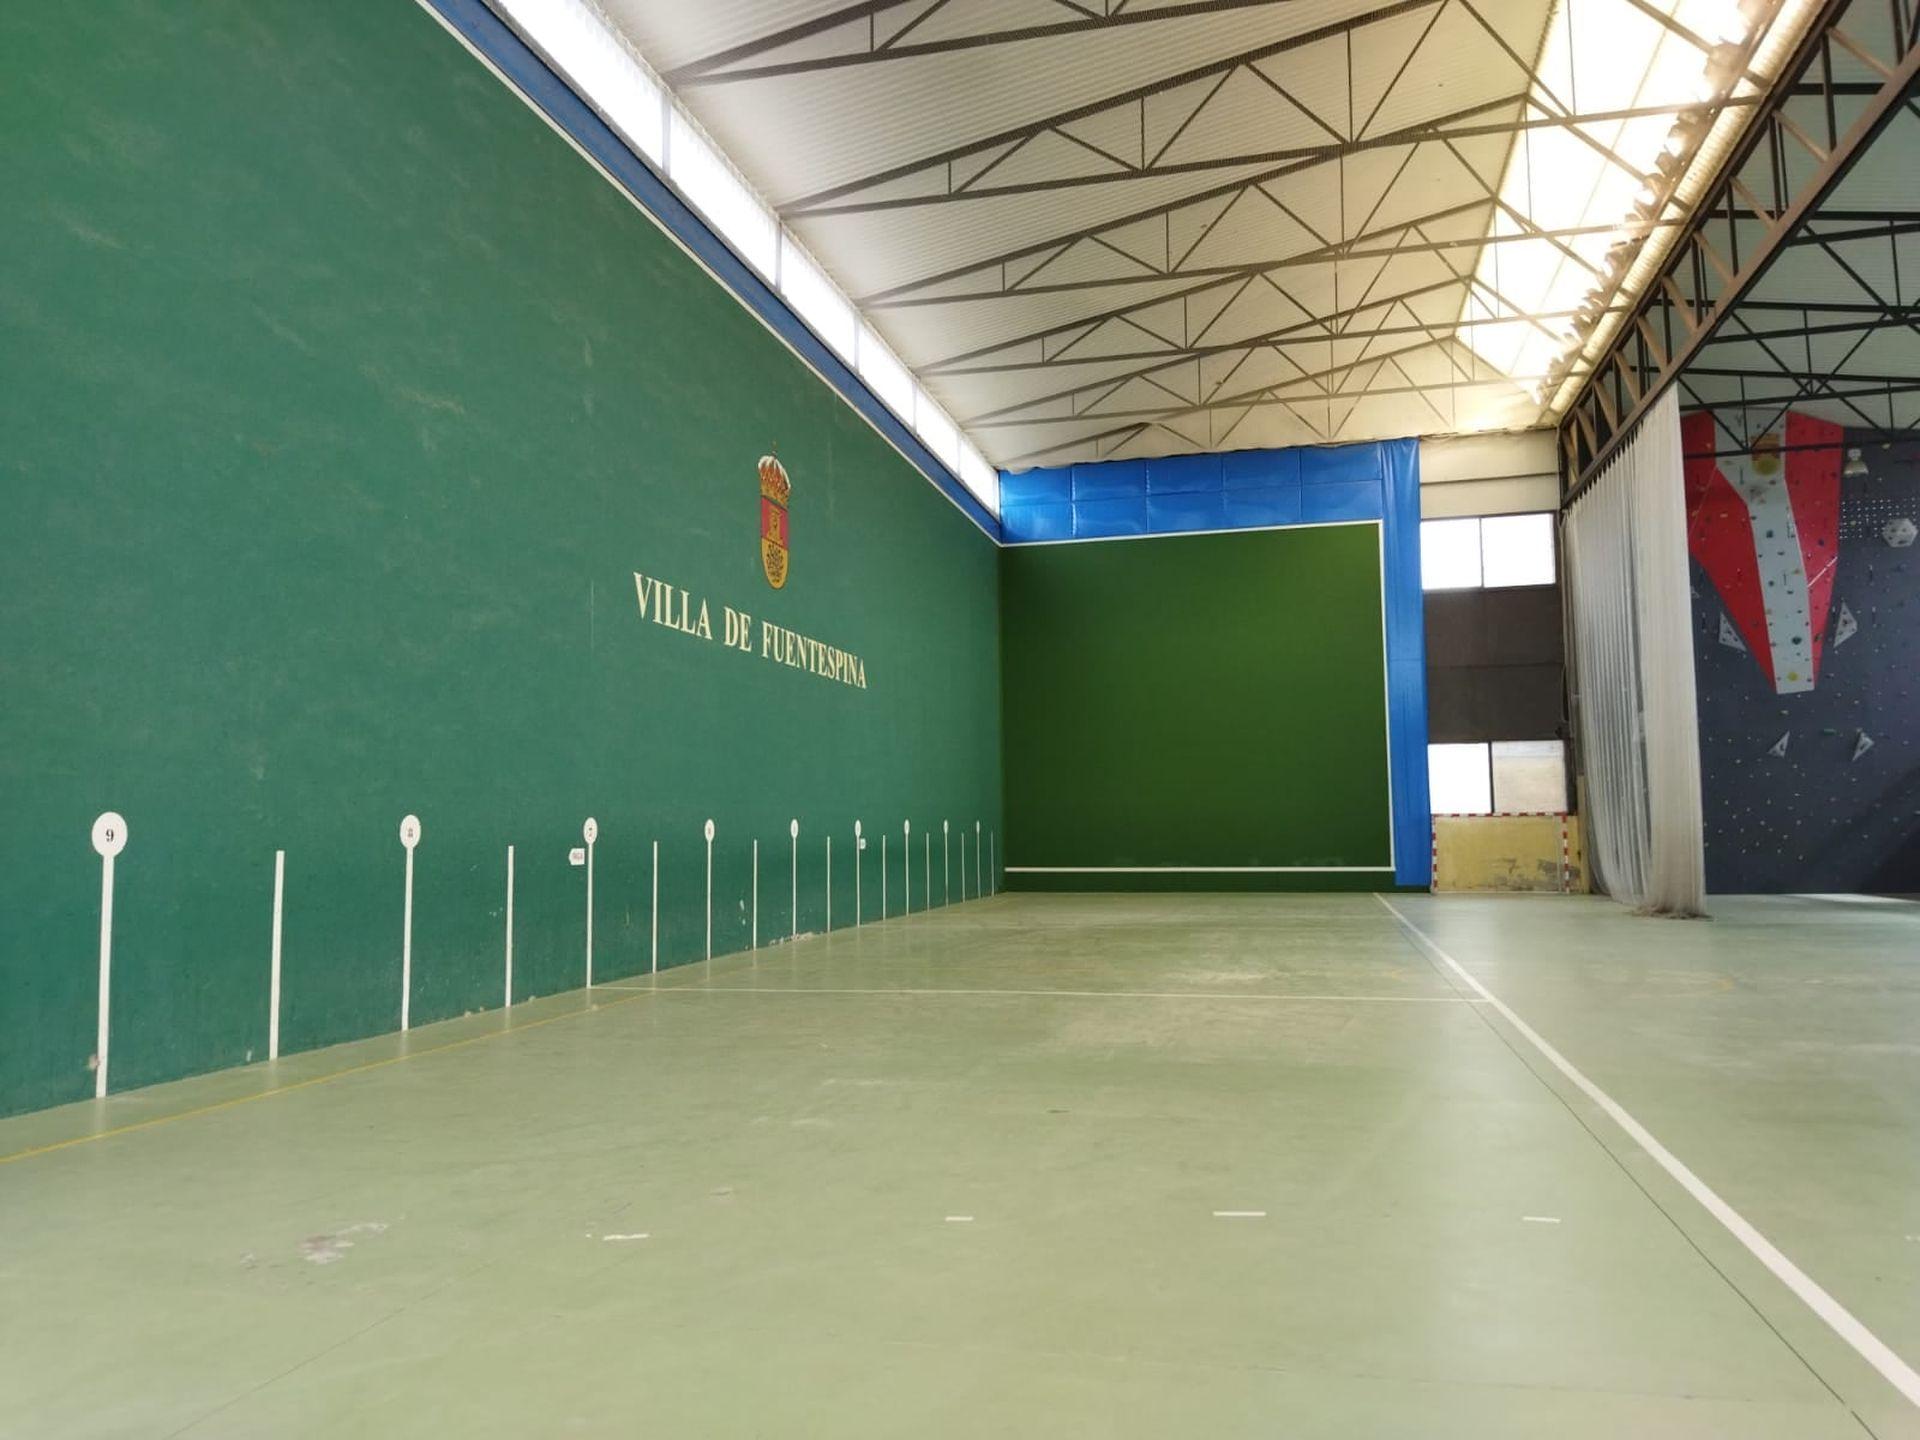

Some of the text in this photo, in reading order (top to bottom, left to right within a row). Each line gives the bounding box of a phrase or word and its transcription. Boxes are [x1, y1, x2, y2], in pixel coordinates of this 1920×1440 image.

[633, 572, 867, 689] VILLA DE FUENTESPINA
[106, 829, 114, 841] 9
